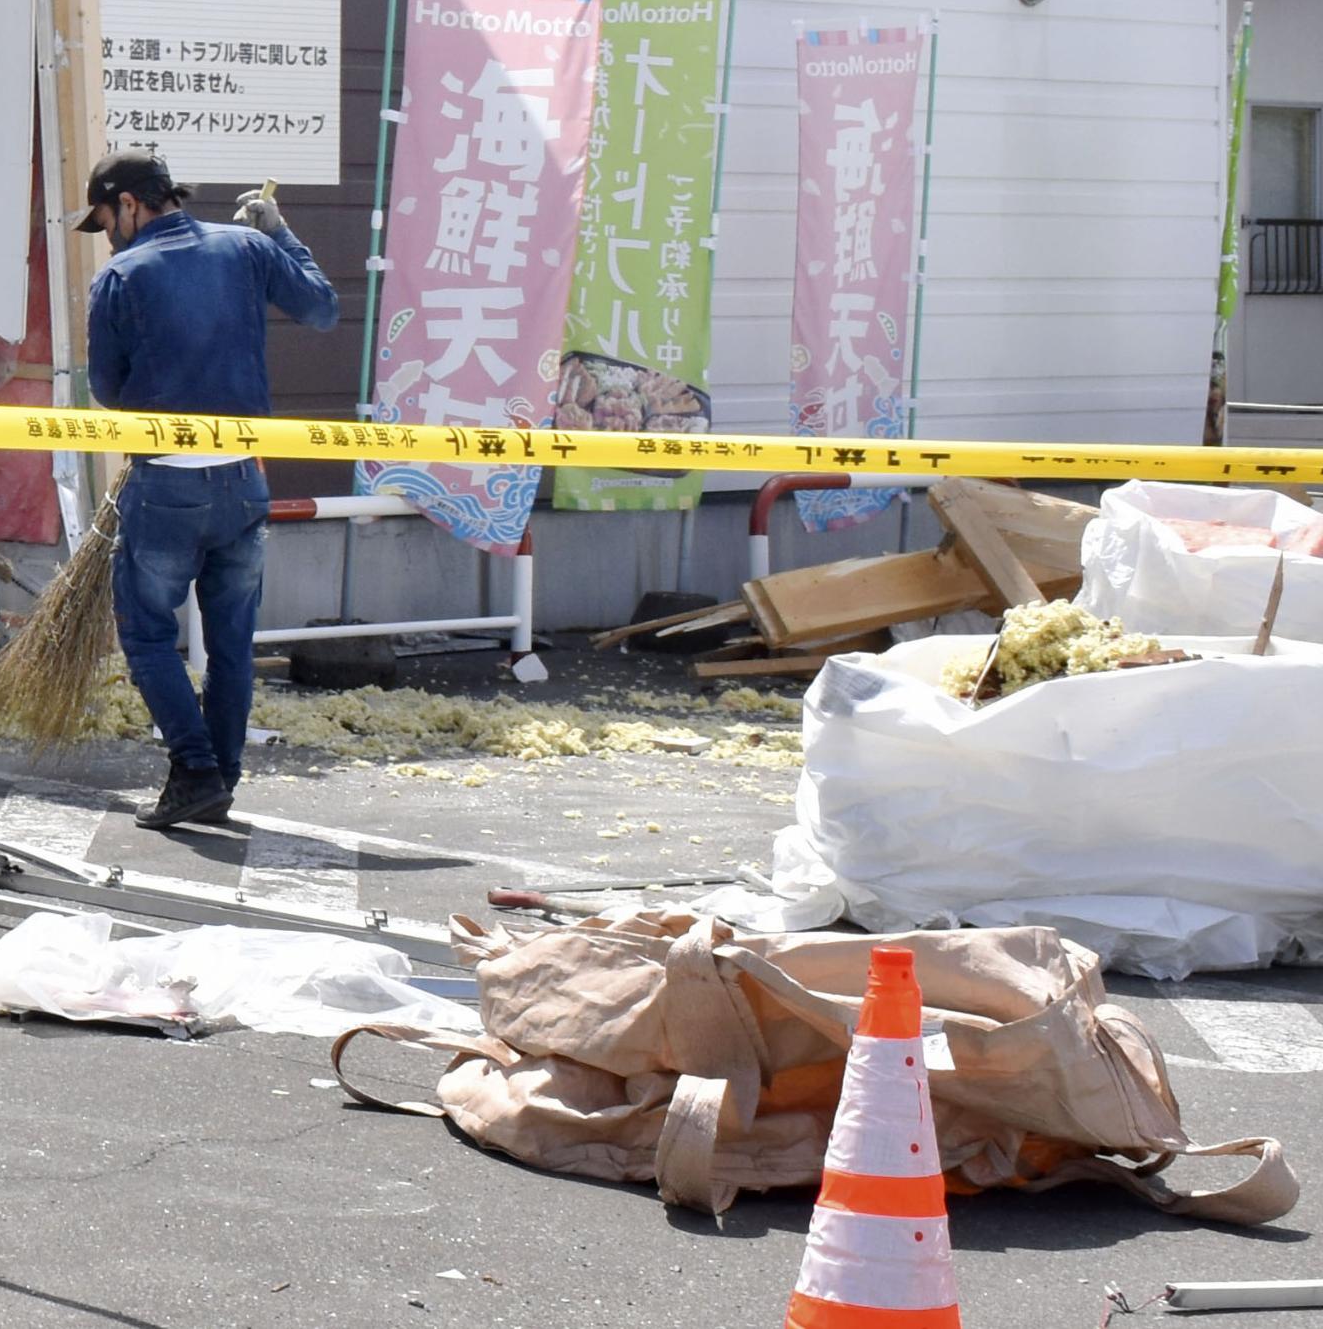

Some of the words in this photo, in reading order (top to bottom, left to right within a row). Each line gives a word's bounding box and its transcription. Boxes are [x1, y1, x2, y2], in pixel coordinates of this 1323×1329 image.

[414, 0, 592, 38] HottoMotto
[27, 419, 122, 441] 北海道警察
[145, 418, 259, 450] 立入禁止
